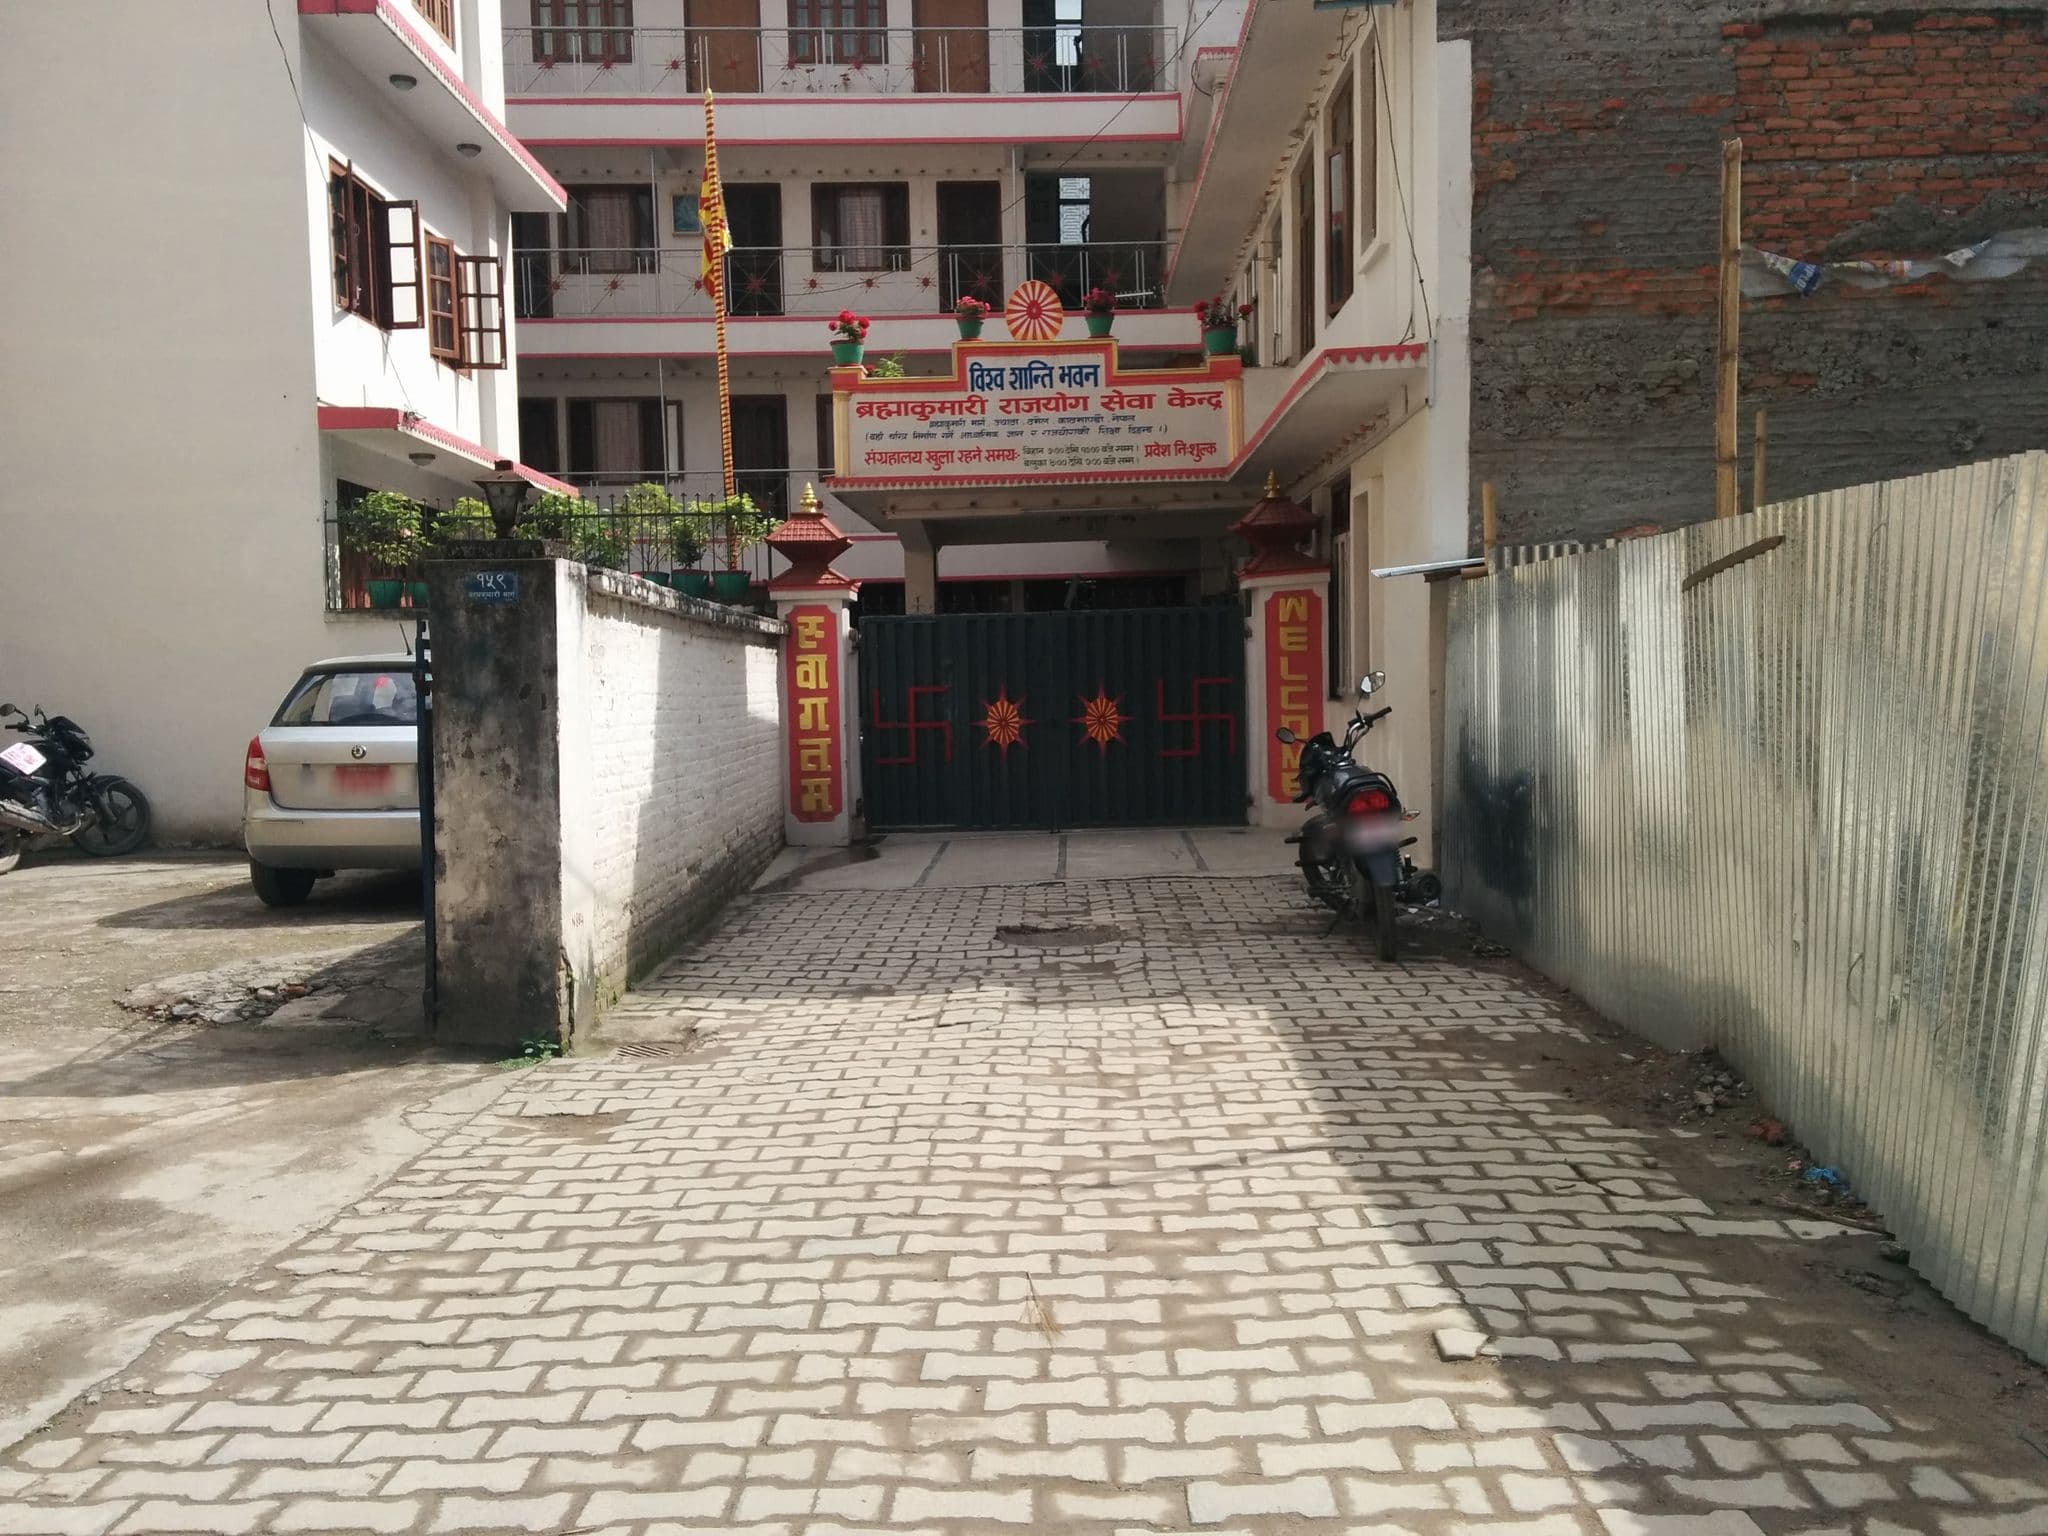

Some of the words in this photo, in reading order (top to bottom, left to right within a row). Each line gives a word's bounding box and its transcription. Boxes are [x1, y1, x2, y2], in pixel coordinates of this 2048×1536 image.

[969, 361, 1006, 392] विश्व
[1009, 359, 1054, 391] शान्ति
[1058, 364, 1101, 388] भवन
[855, 394, 988, 421] ब्रह्माकुमारी
[999, 389, 1090, 415] राजयोग
[1100, 389, 1157, 412] सेवा
[1167, 386, 1225, 411] केन्द्र
[864, 448, 922, 465] संग्रहालय
[925, 449, 954, 471] खुला
[957, 445, 982, 464] रहने
[1143, 441, 1171, 458] प्रवेश
